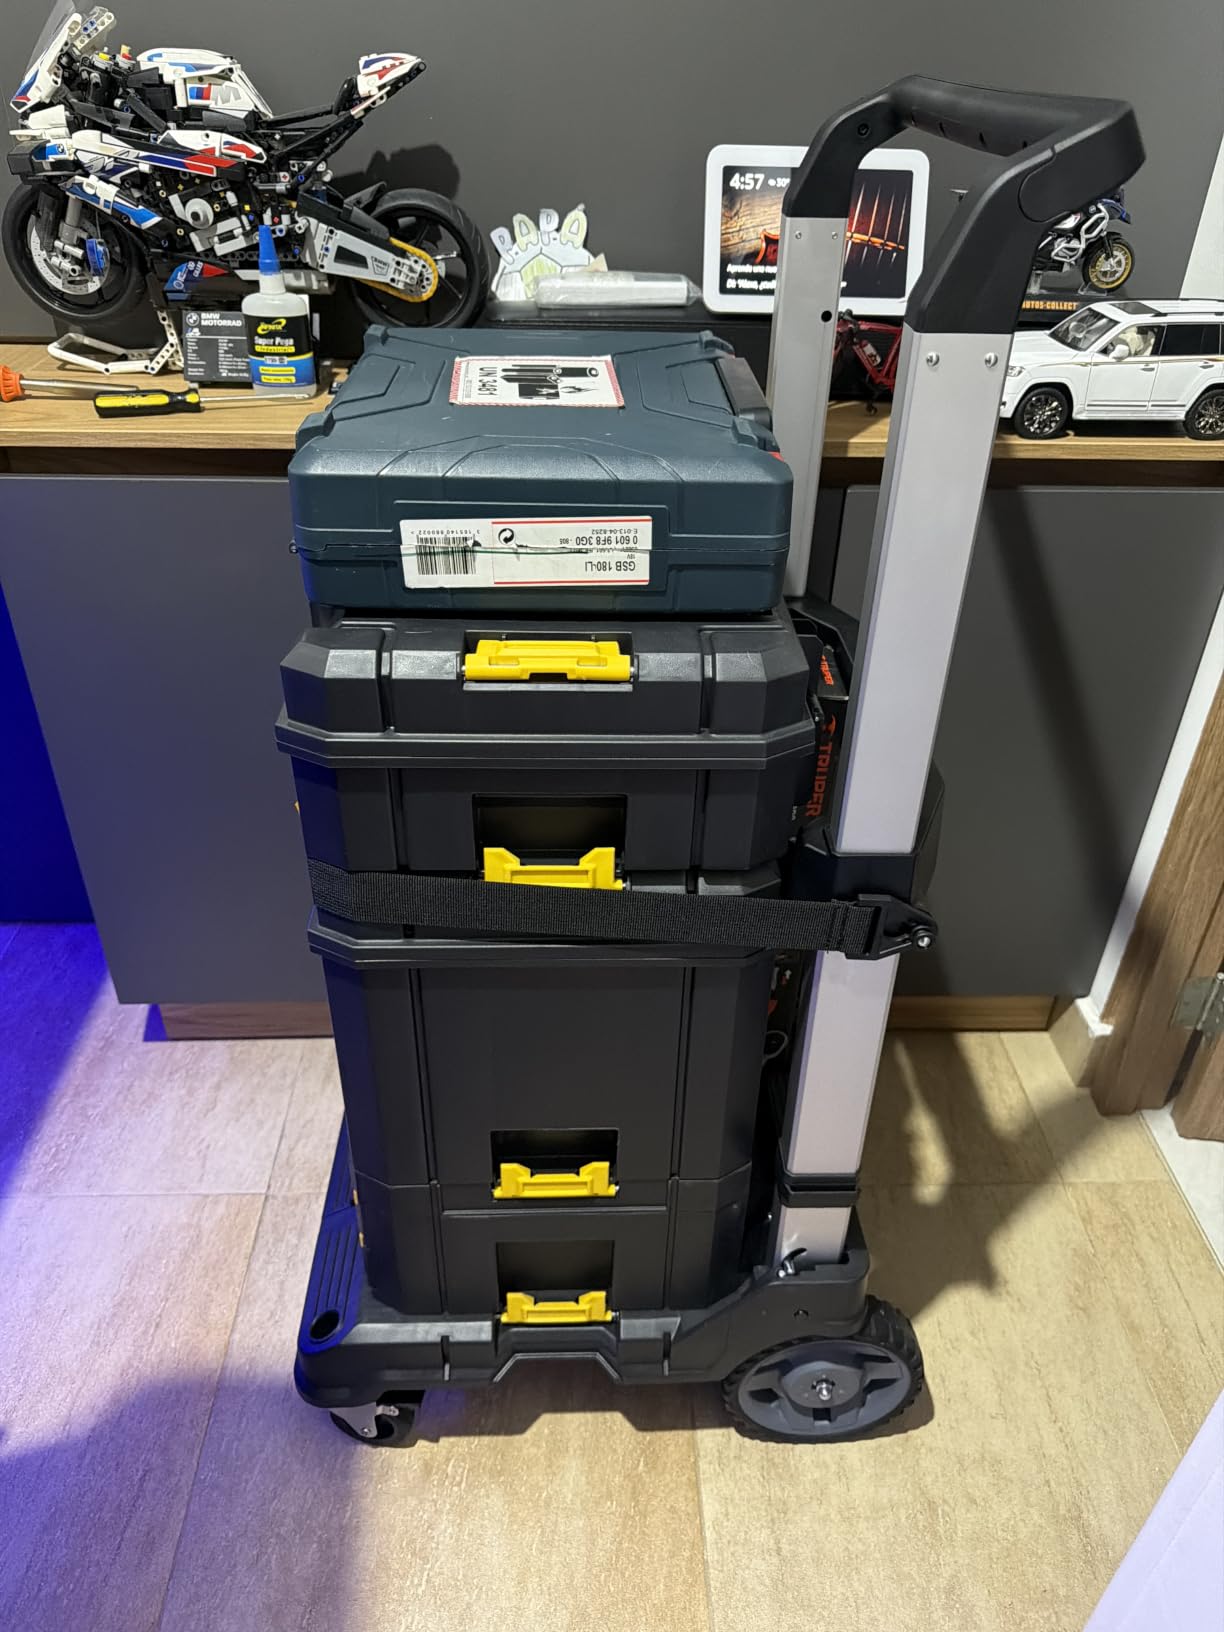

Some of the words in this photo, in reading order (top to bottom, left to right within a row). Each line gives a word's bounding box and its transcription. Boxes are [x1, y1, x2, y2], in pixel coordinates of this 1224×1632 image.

[729, 173, 765, 190] 4:57
[254, 336, 274, 346] Super
[478, 366, 498, 378] UN
[477, 379, 498, 396] 3481
[596, 535, 612, 546] 9F8
[615, 535, 630, 545] 601
[632, 535, 638, 545] 0
[615, 560, 636, 572] GSB
